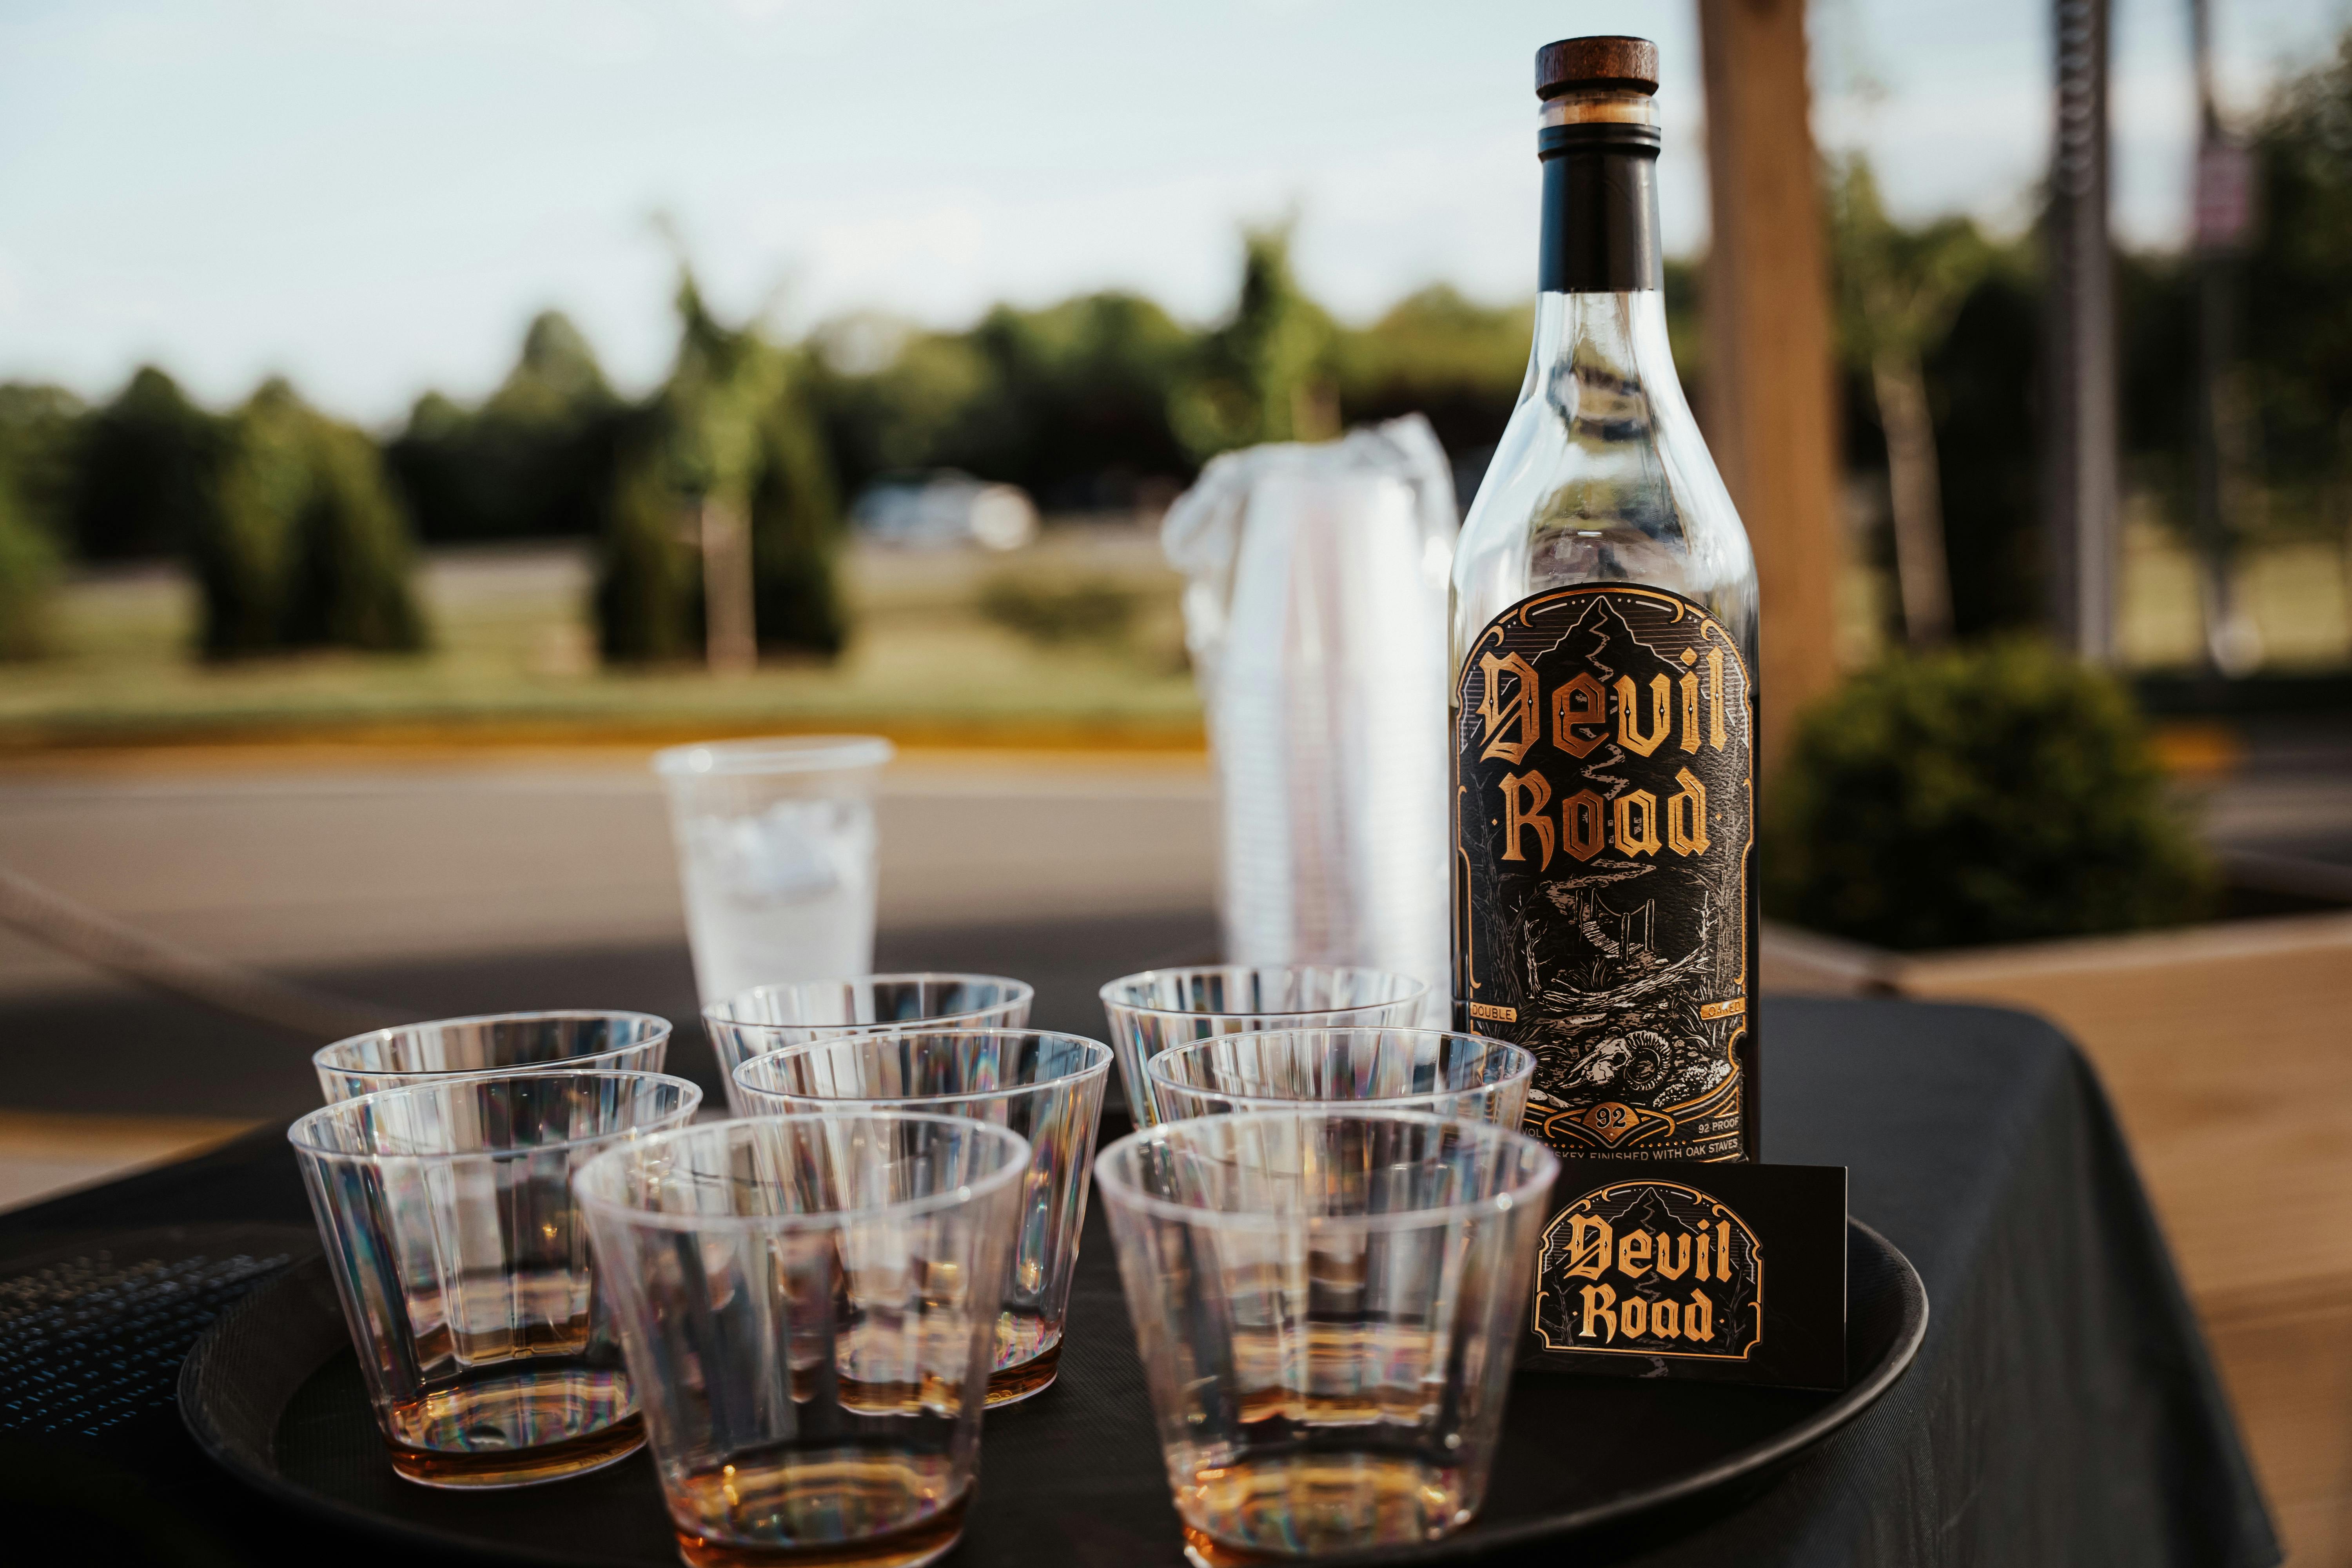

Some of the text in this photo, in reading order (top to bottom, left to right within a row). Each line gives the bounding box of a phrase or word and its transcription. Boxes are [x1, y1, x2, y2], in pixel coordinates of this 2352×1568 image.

[1475, 646, 1727, 765] Devil
[1499, 766, 1711, 872] Road
[1472, 1004, 1513, 1020] DOUBLE
[1595, 1107, 1626, 1129] 92
[1699, 1116, 1739, 1133] 92 PROOF
[1522, 1127, 1543, 1138] VOL
[1590, 1151, 1648, 1160] FINISHED
[1653, 1148, 1682, 1160] WITH
[1686, 1145, 1706, 1156] OAK
[1709, 1138, 1738, 1153] STAVES
[1563, 1213, 1732, 1283] Devil
[1578, 1283, 1716, 1343] Road
